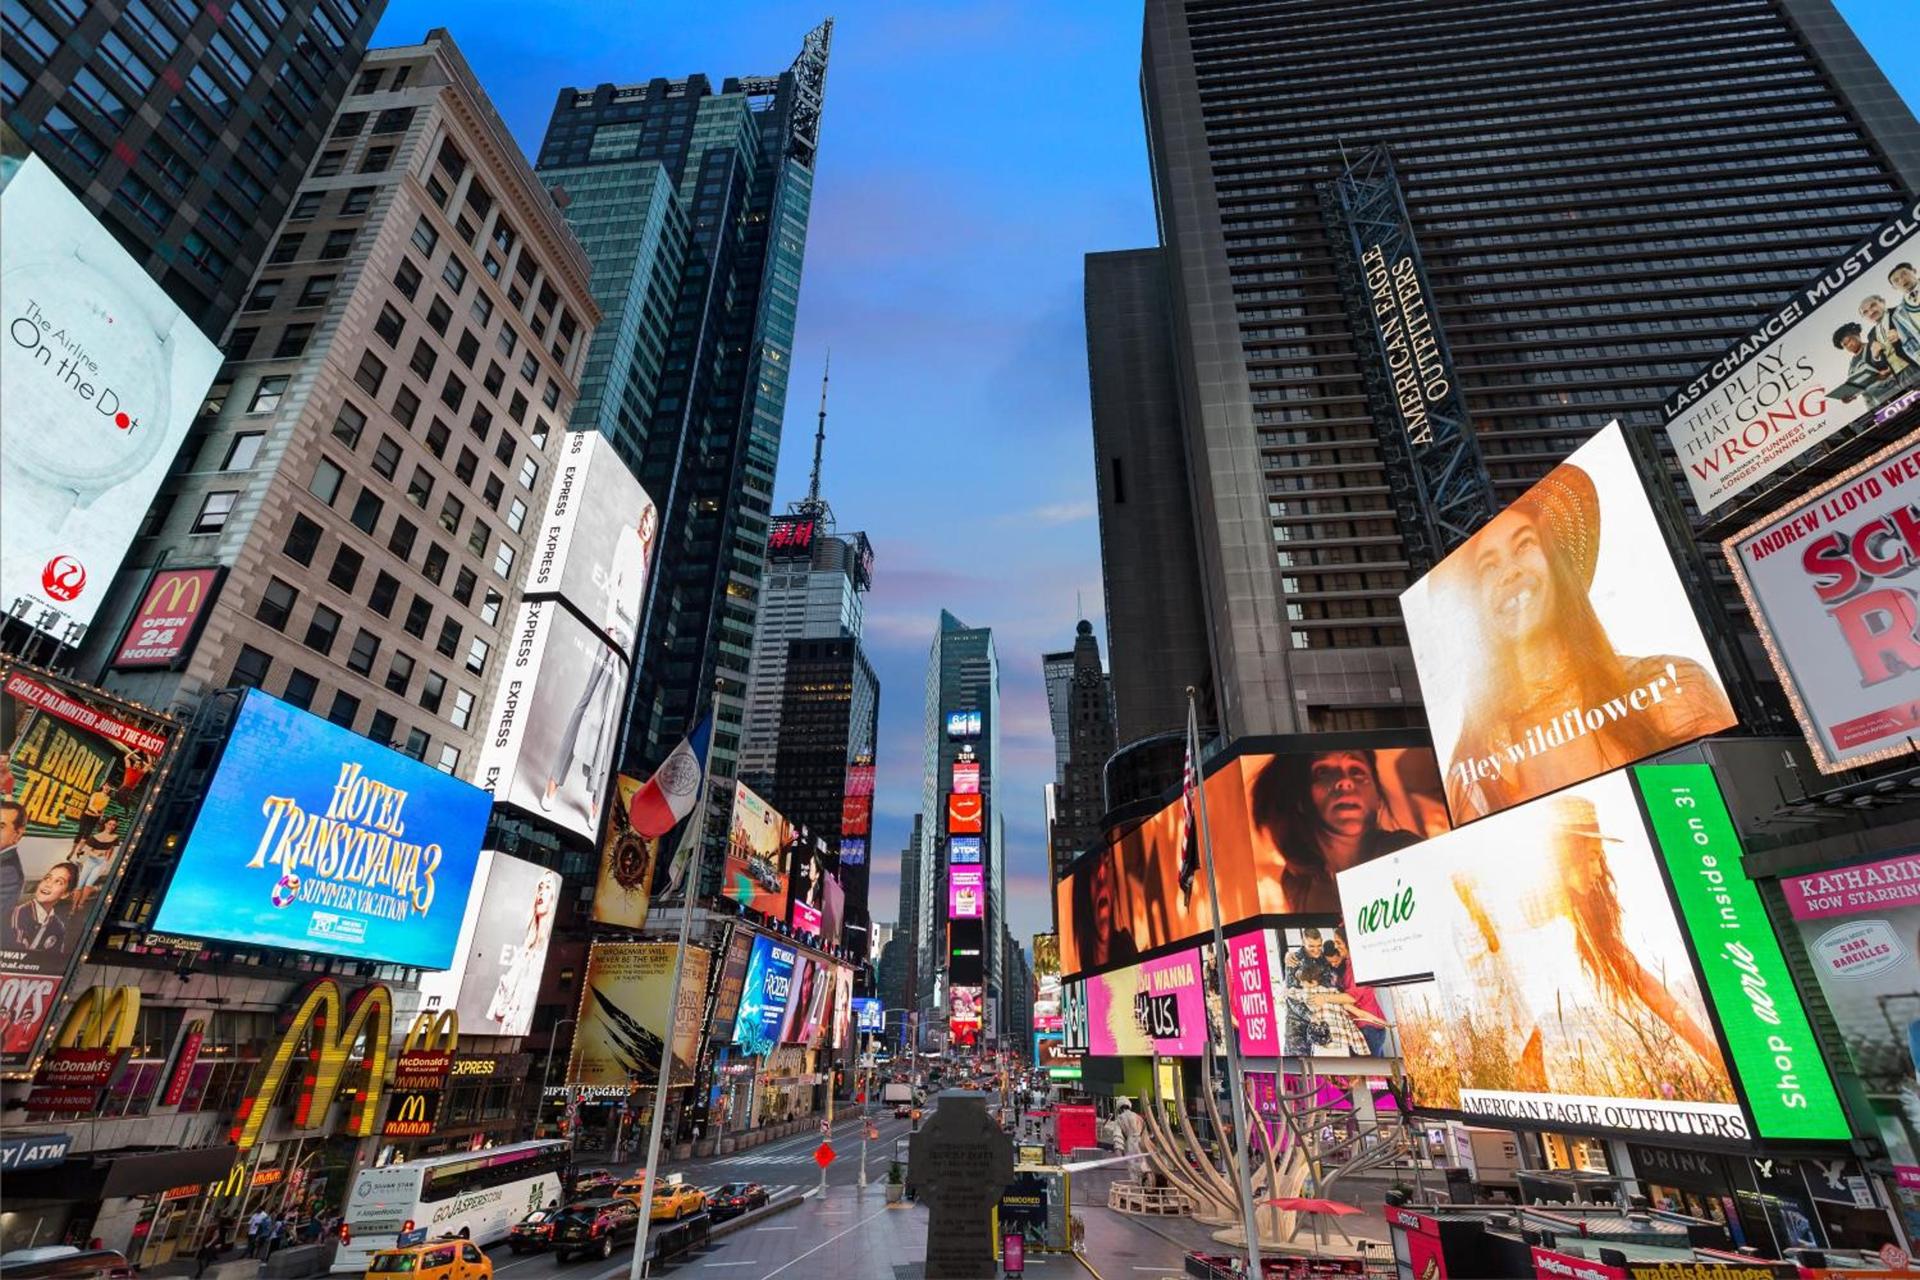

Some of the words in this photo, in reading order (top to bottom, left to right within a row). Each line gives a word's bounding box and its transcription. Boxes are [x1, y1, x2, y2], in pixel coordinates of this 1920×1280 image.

[1362, 244, 1396, 318] EAGLE
[24, 299, 52, 334] The
[1391, 256, 1449, 402] OUTFITTERS
[1664, 373, 1709, 417] LAST
[1712, 301, 1803, 381] CHANCE!
[1807, 242, 1875, 307] MUST
[1879, 203, 1920, 248] CL
[10, 317, 53, 368] On
[55, 353, 96, 402] the
[1381, 316, 1433, 445] AMERICAN
[1683, 403, 1723, 433] THE
[1723, 344, 1787, 405] PLAY
[1683, 418, 1730, 457] THAT
[1735, 355, 1815, 423] GOES
[1691, 388, 1827, 482] WRONG
[553, 466, 577, 516] EXPRESS
[1821, 473, 1882, 527] LLOYD
[537, 526, 562, 584] EXPRESS
[47, 584, 71, 600] JAL
[139, 628, 174, 646] 24
[141, 617, 186, 629] OPEN
[515, 600, 544, 668] EXPRESS
[122, 645, 178, 661] HOURS
[8, 678, 44, 704] CHAZZ
[40, 693, 96, 726] PALMINTERI
[95, 718, 126, 737] JOINS
[122, 728, 140, 746] THE
[138, 734, 165, 752] CAST!
[495, 680, 523, 749] EXPRESS
[1456, 757, 1503, 785] Hey
[1500, 663, 1684, 764] wildflower!
[17, 716, 51, 765] A
[40, 728, 104, 794] BRONX
[19, 769, 73, 825] TALE
[325, 763, 408, 837] HOTEL
[1671, 788, 1696, 808] 3!
[960, 846, 979, 854] TDK
[1688, 818, 1709, 846] on
[246, 796, 420, 898] TRANSYLVANIA
[413, 844, 443, 918] 3
[298, 876, 357, 912] SUMMER
[357, 886, 408, 921] VACATION
[1358, 878, 1416, 936] aerie
[1700, 855, 1741, 929] inside
[1806, 896, 1843, 912] NOW
[1238, 945, 1259, 968] ARE
[1832, 943, 1890, 969] BAREILLES
[1840, 938, 1869, 954] SARA
[762, 968, 791, 1000] FROZEN
[1153, 963, 1195, 991] WANNA
[1239, 968, 1262, 992] YOU
[1720, 941, 1781, 1025] aerie
[1151, 997, 1179, 1037] US.
[1240, 992, 1268, 1016] WITH
[1246, 1017, 1267, 1040] US?
[43, 1059, 112, 1072] McDonald's
[399, 1058, 449, 1067] McDonald's
[452, 1060, 495, 1075] EXPRESS
[1462, 1095, 1541, 1120] AMERICAN
[1546, 1101, 1601, 1126] EAGLE
[1605, 1106, 1748, 1140] OUTFITTERS
[1641, 1151, 1713, 1176] DRINK
